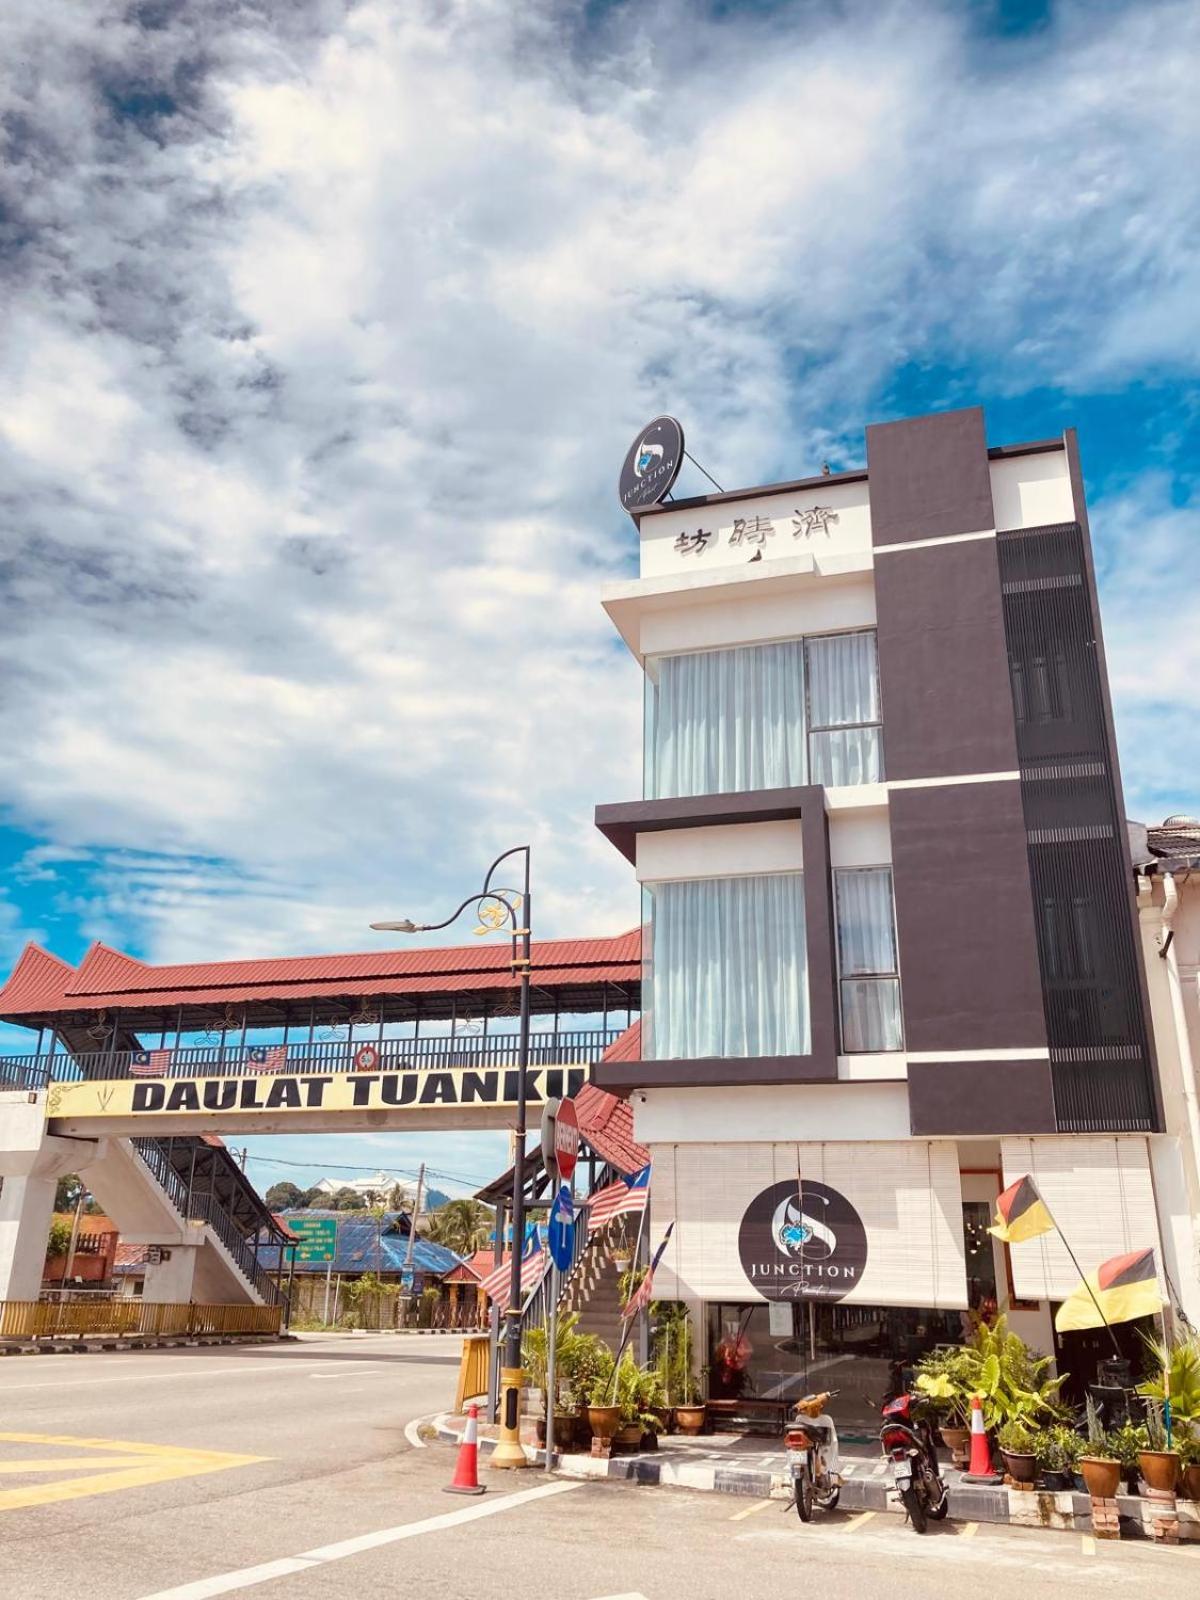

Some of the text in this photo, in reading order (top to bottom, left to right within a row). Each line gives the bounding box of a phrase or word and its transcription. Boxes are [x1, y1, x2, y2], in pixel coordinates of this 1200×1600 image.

[623, 459, 674, 502] JUNCTION
[131, 1068, 585, 1111] DAULAT TUANKU
[751, 1263, 855, 1278] JUNCTION
